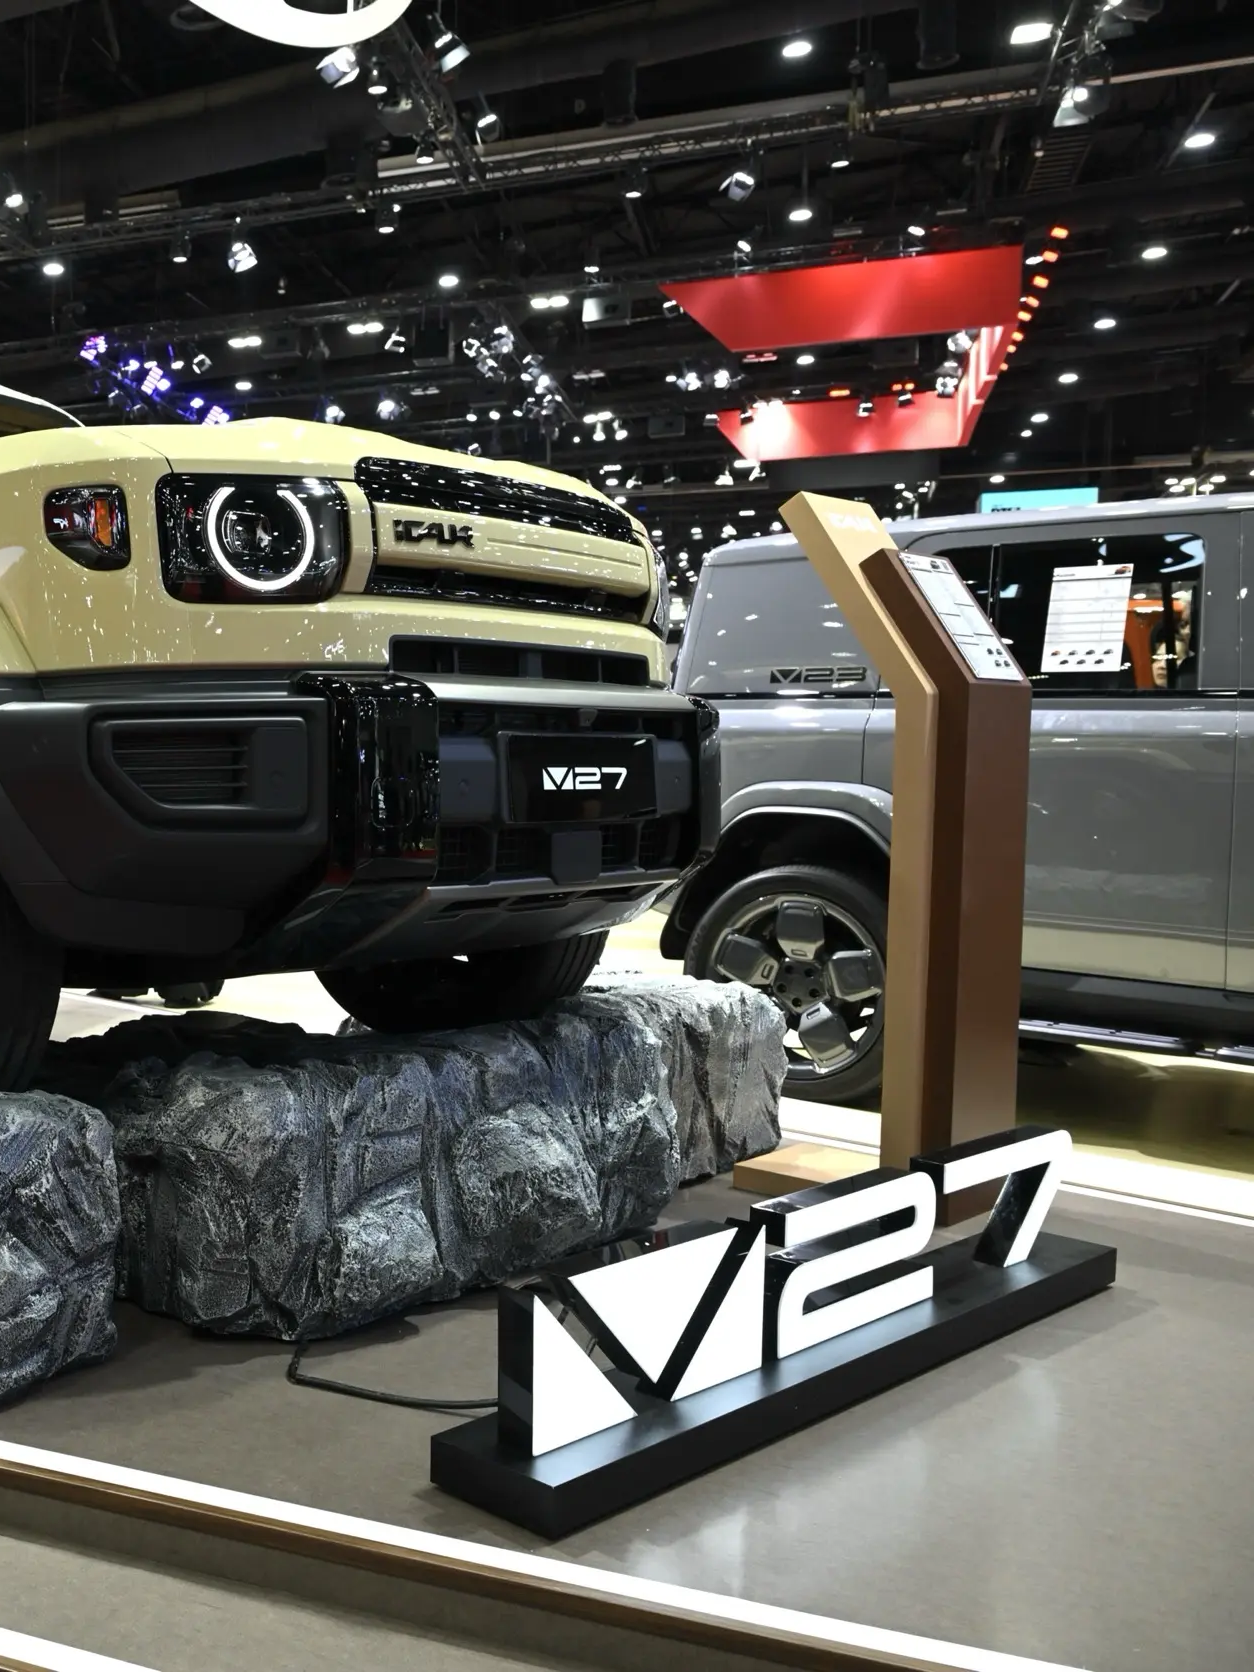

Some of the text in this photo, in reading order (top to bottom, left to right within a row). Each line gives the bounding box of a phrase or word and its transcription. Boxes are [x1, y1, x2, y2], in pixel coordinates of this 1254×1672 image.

[769, 666, 867, 684] V23
[542, 766, 628, 790] V27
[530, 1128, 1074, 1458] V27
